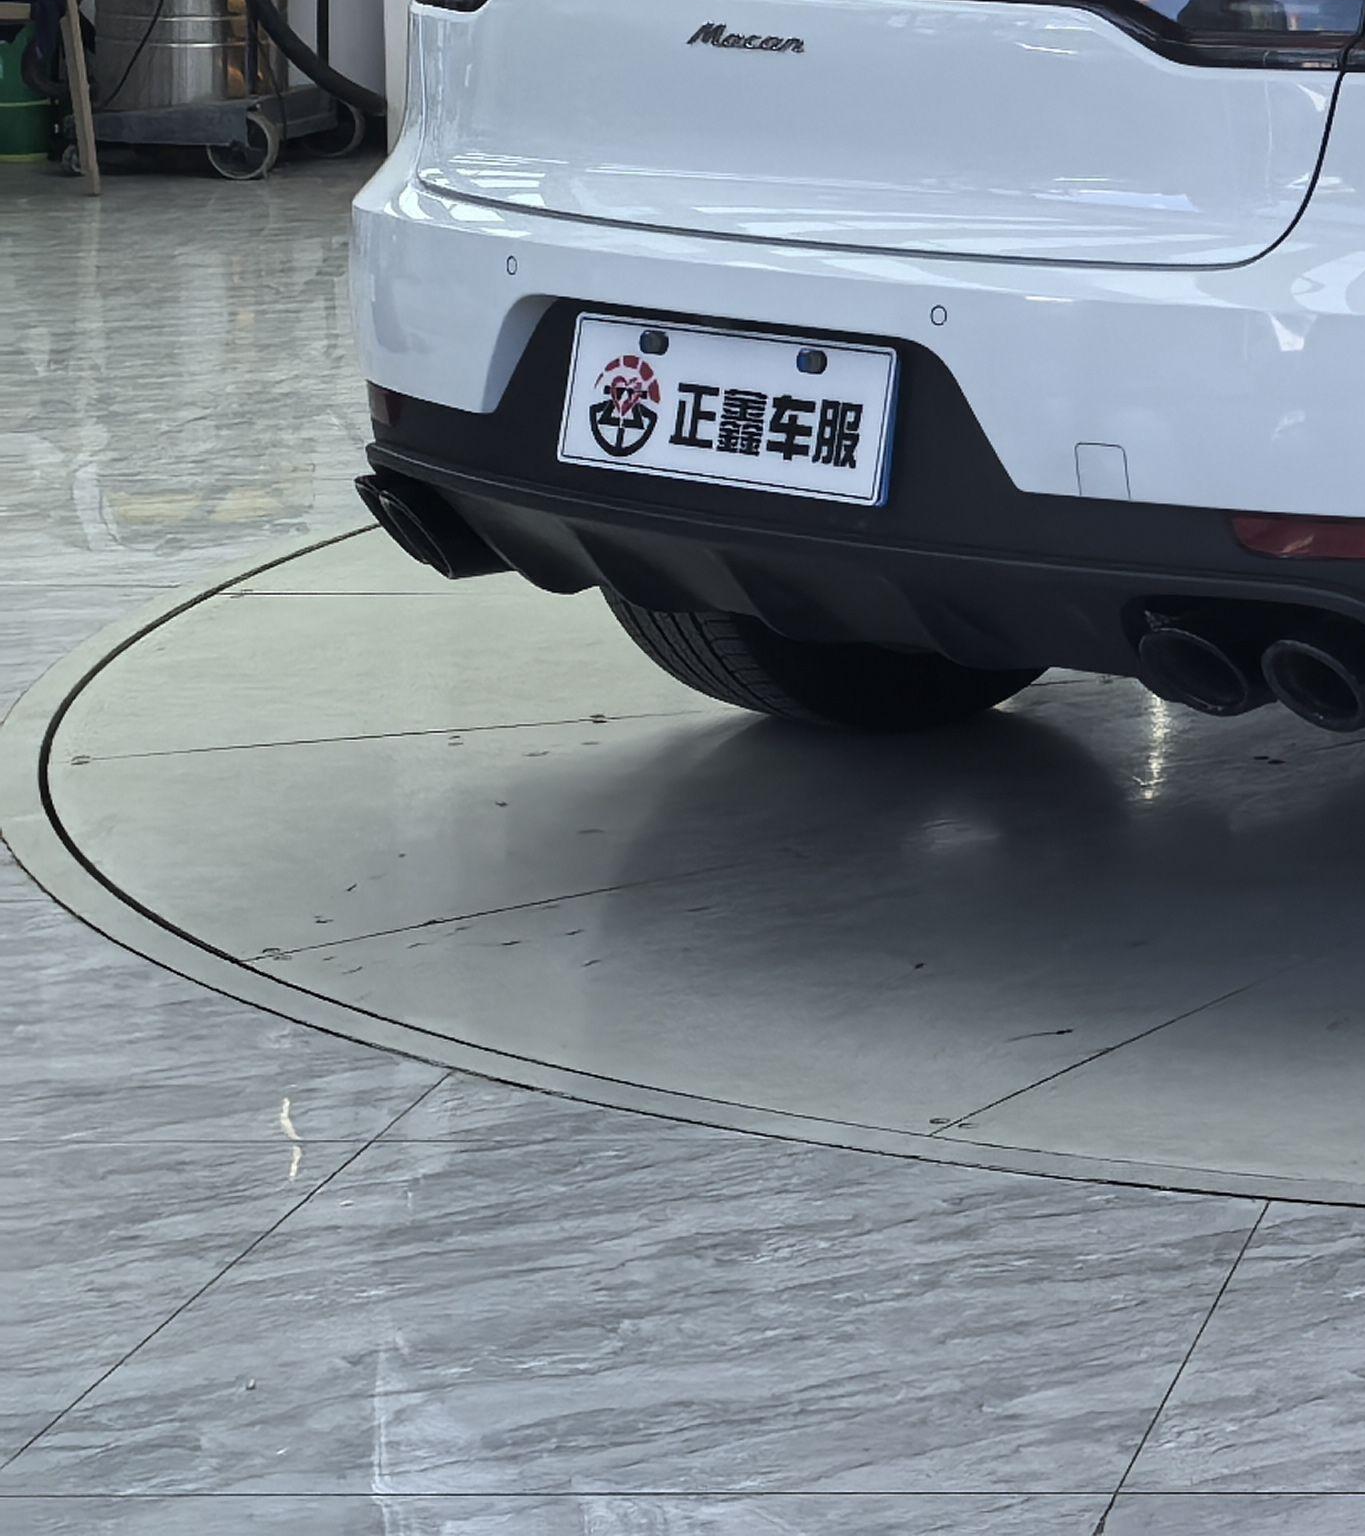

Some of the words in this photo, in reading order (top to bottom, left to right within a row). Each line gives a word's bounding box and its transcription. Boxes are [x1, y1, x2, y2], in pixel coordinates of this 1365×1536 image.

[686, 21, 806, 55] Macan
[668, 382, 865, 470] 正鑫车服
